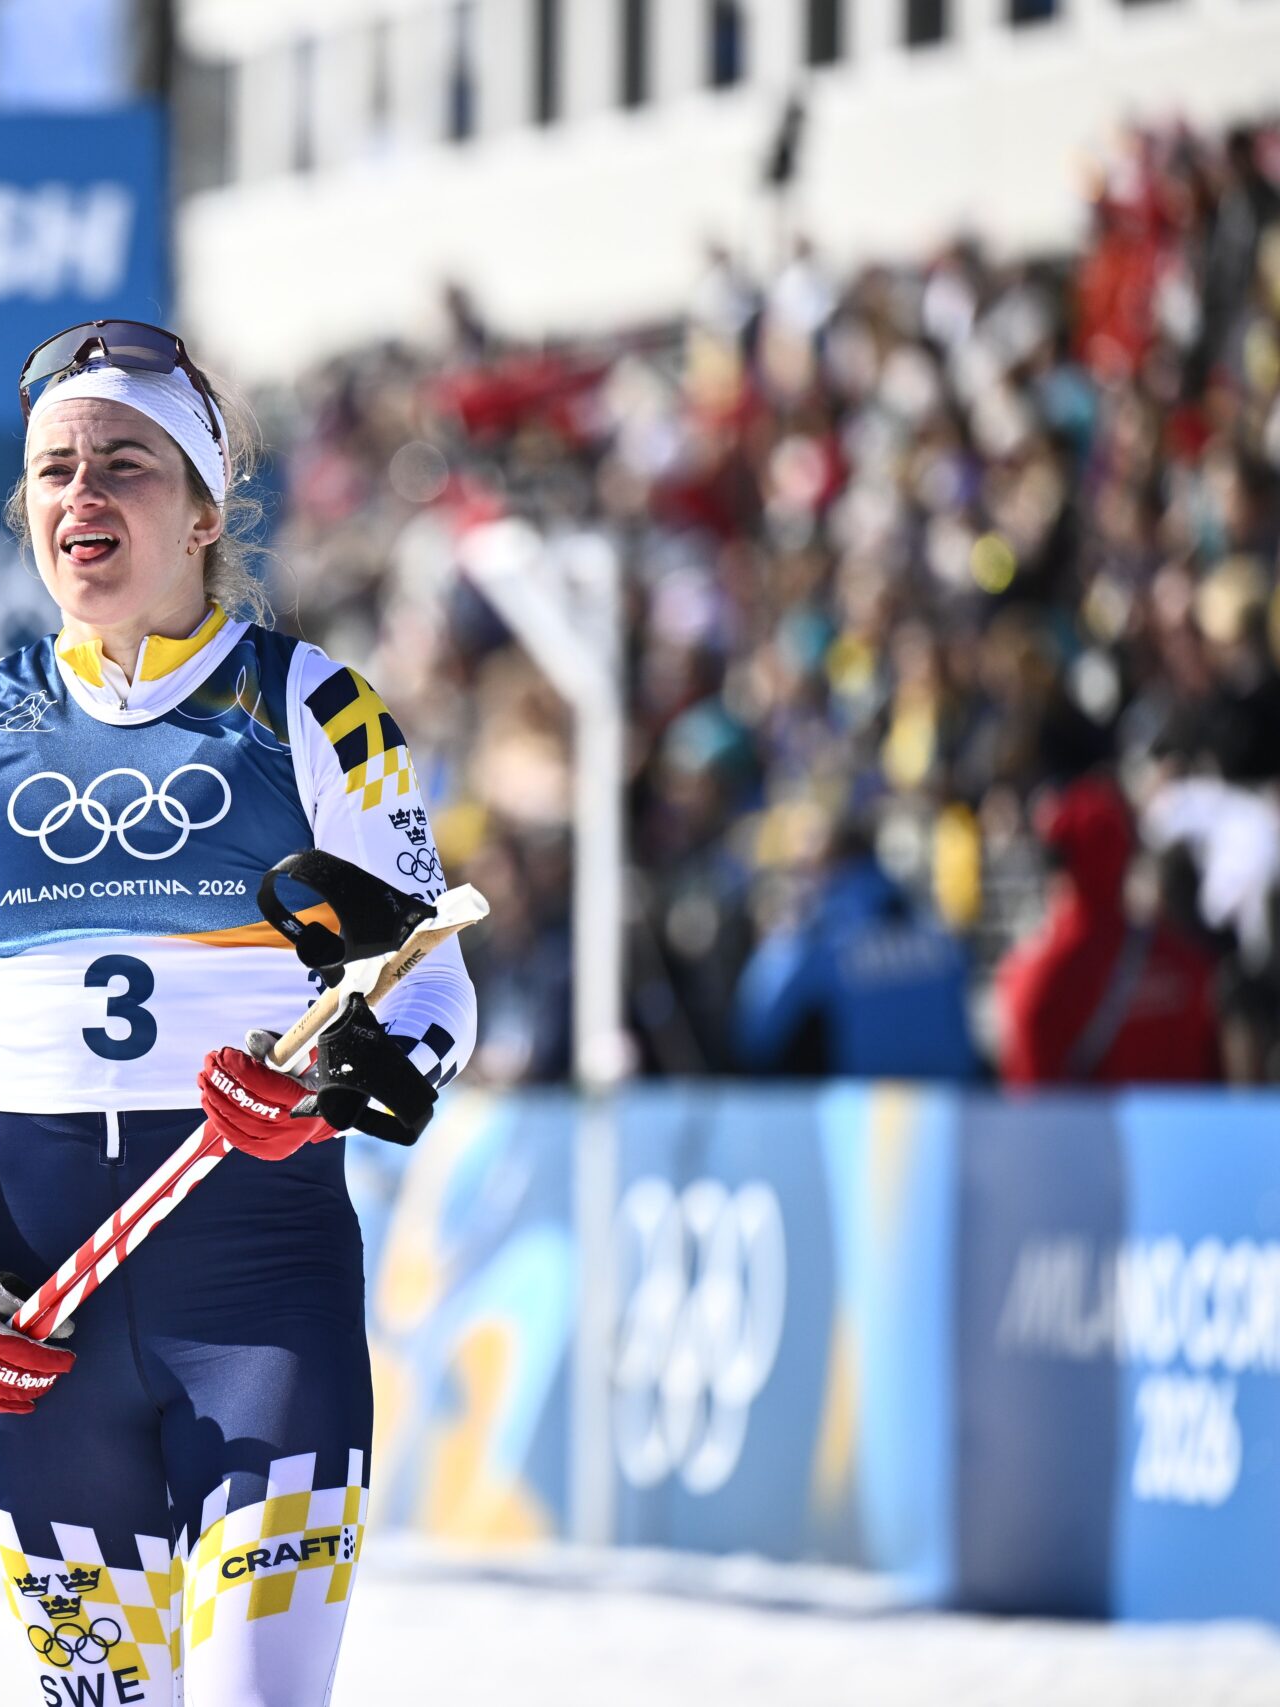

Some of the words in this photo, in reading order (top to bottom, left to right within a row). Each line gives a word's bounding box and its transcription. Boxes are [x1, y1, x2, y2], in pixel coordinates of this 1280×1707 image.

[0, 883, 85, 906] MILANO
[89, 879, 192, 898] CORTINA
[198, 879, 246, 896] 2026
[82, 954, 157, 1061] 3
[351, 1025, 376, 1040] TCS
[221, 1534, 341, 1579] CRAFT
[40, 1665, 145, 1707] SWE
